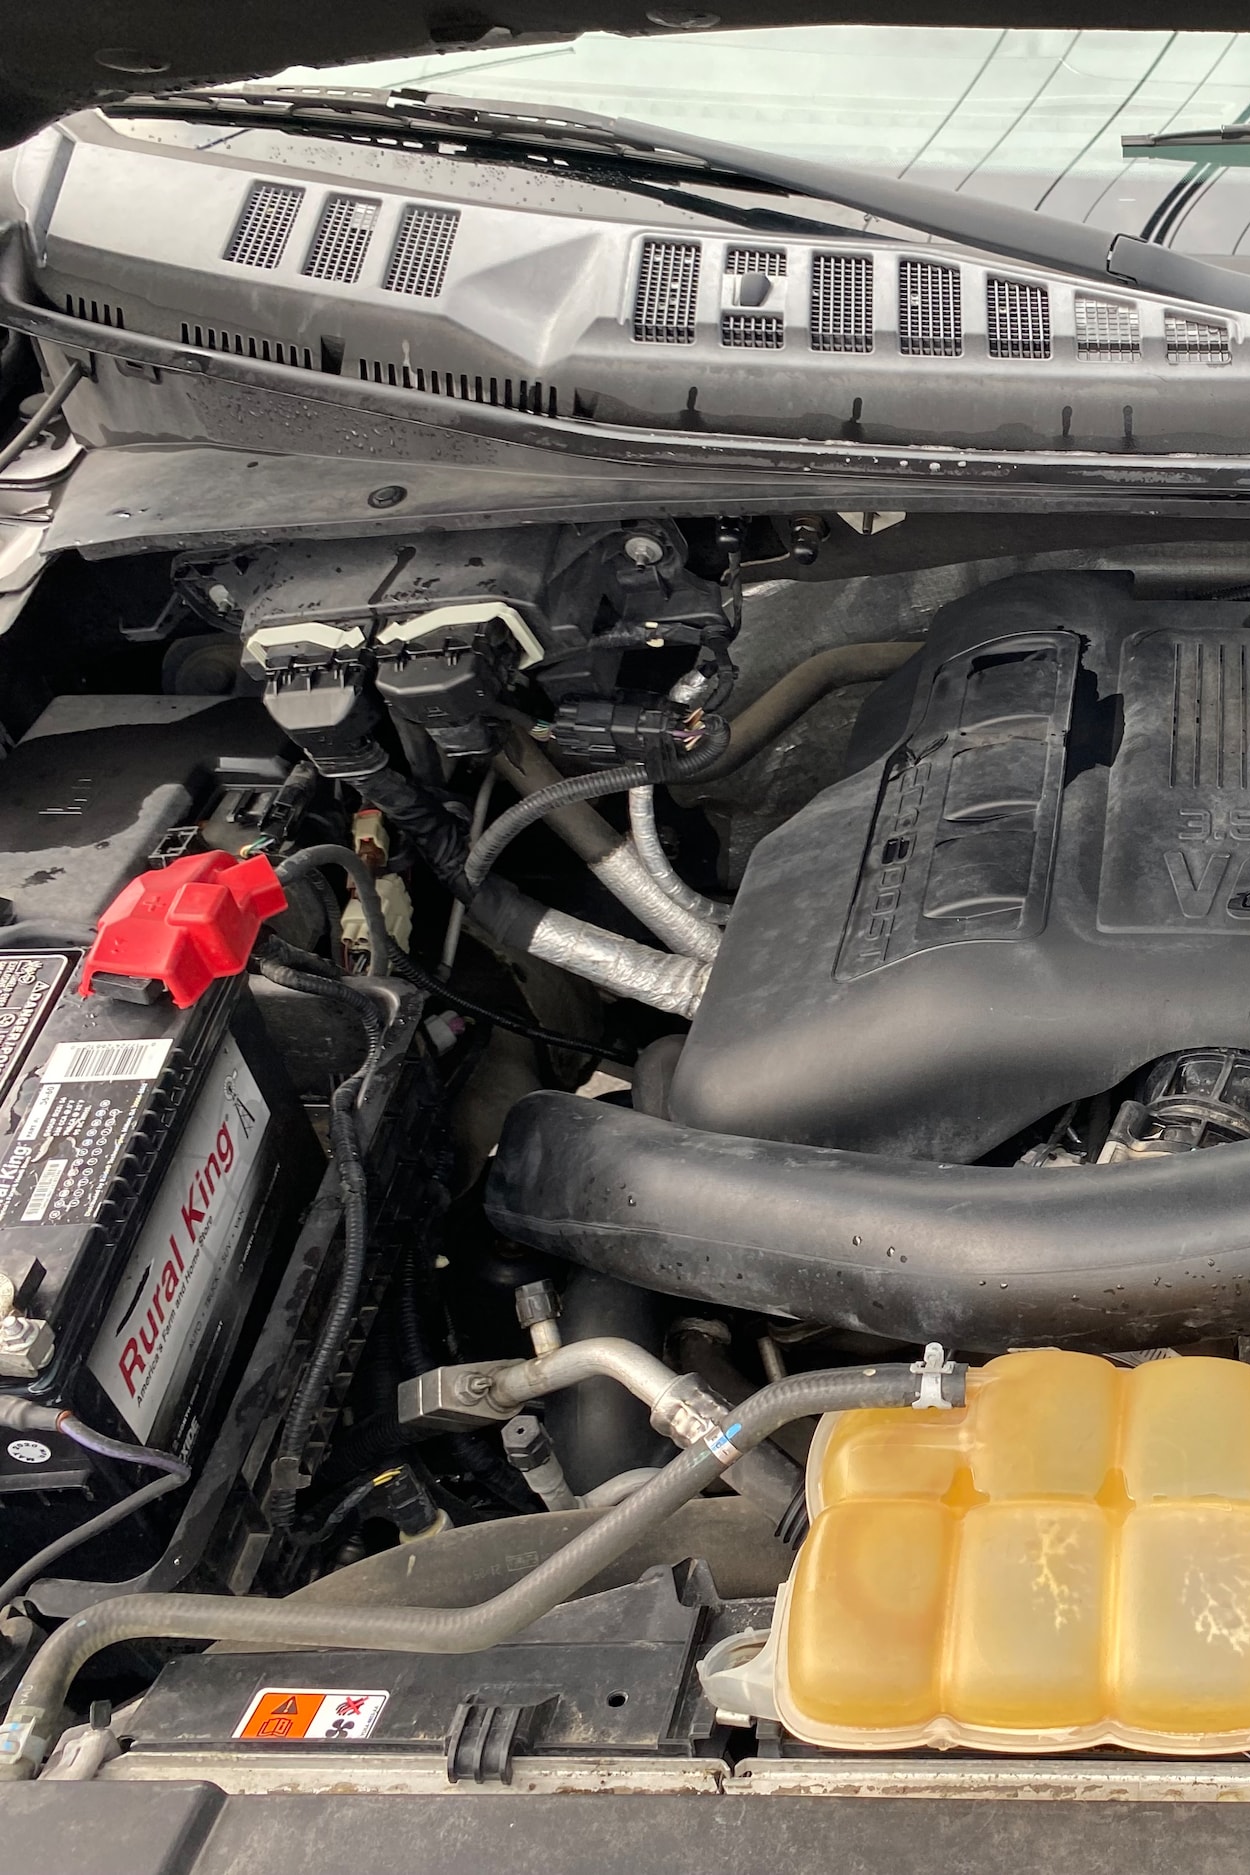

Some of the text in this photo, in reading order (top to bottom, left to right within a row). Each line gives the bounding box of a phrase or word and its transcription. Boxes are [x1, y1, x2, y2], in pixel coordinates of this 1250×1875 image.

[859, 762, 932, 961] ECOBOOST
[118, 1119, 235, 1397] Rural King
[137, 1213, 213, 1407] America's Farm and Home Store
